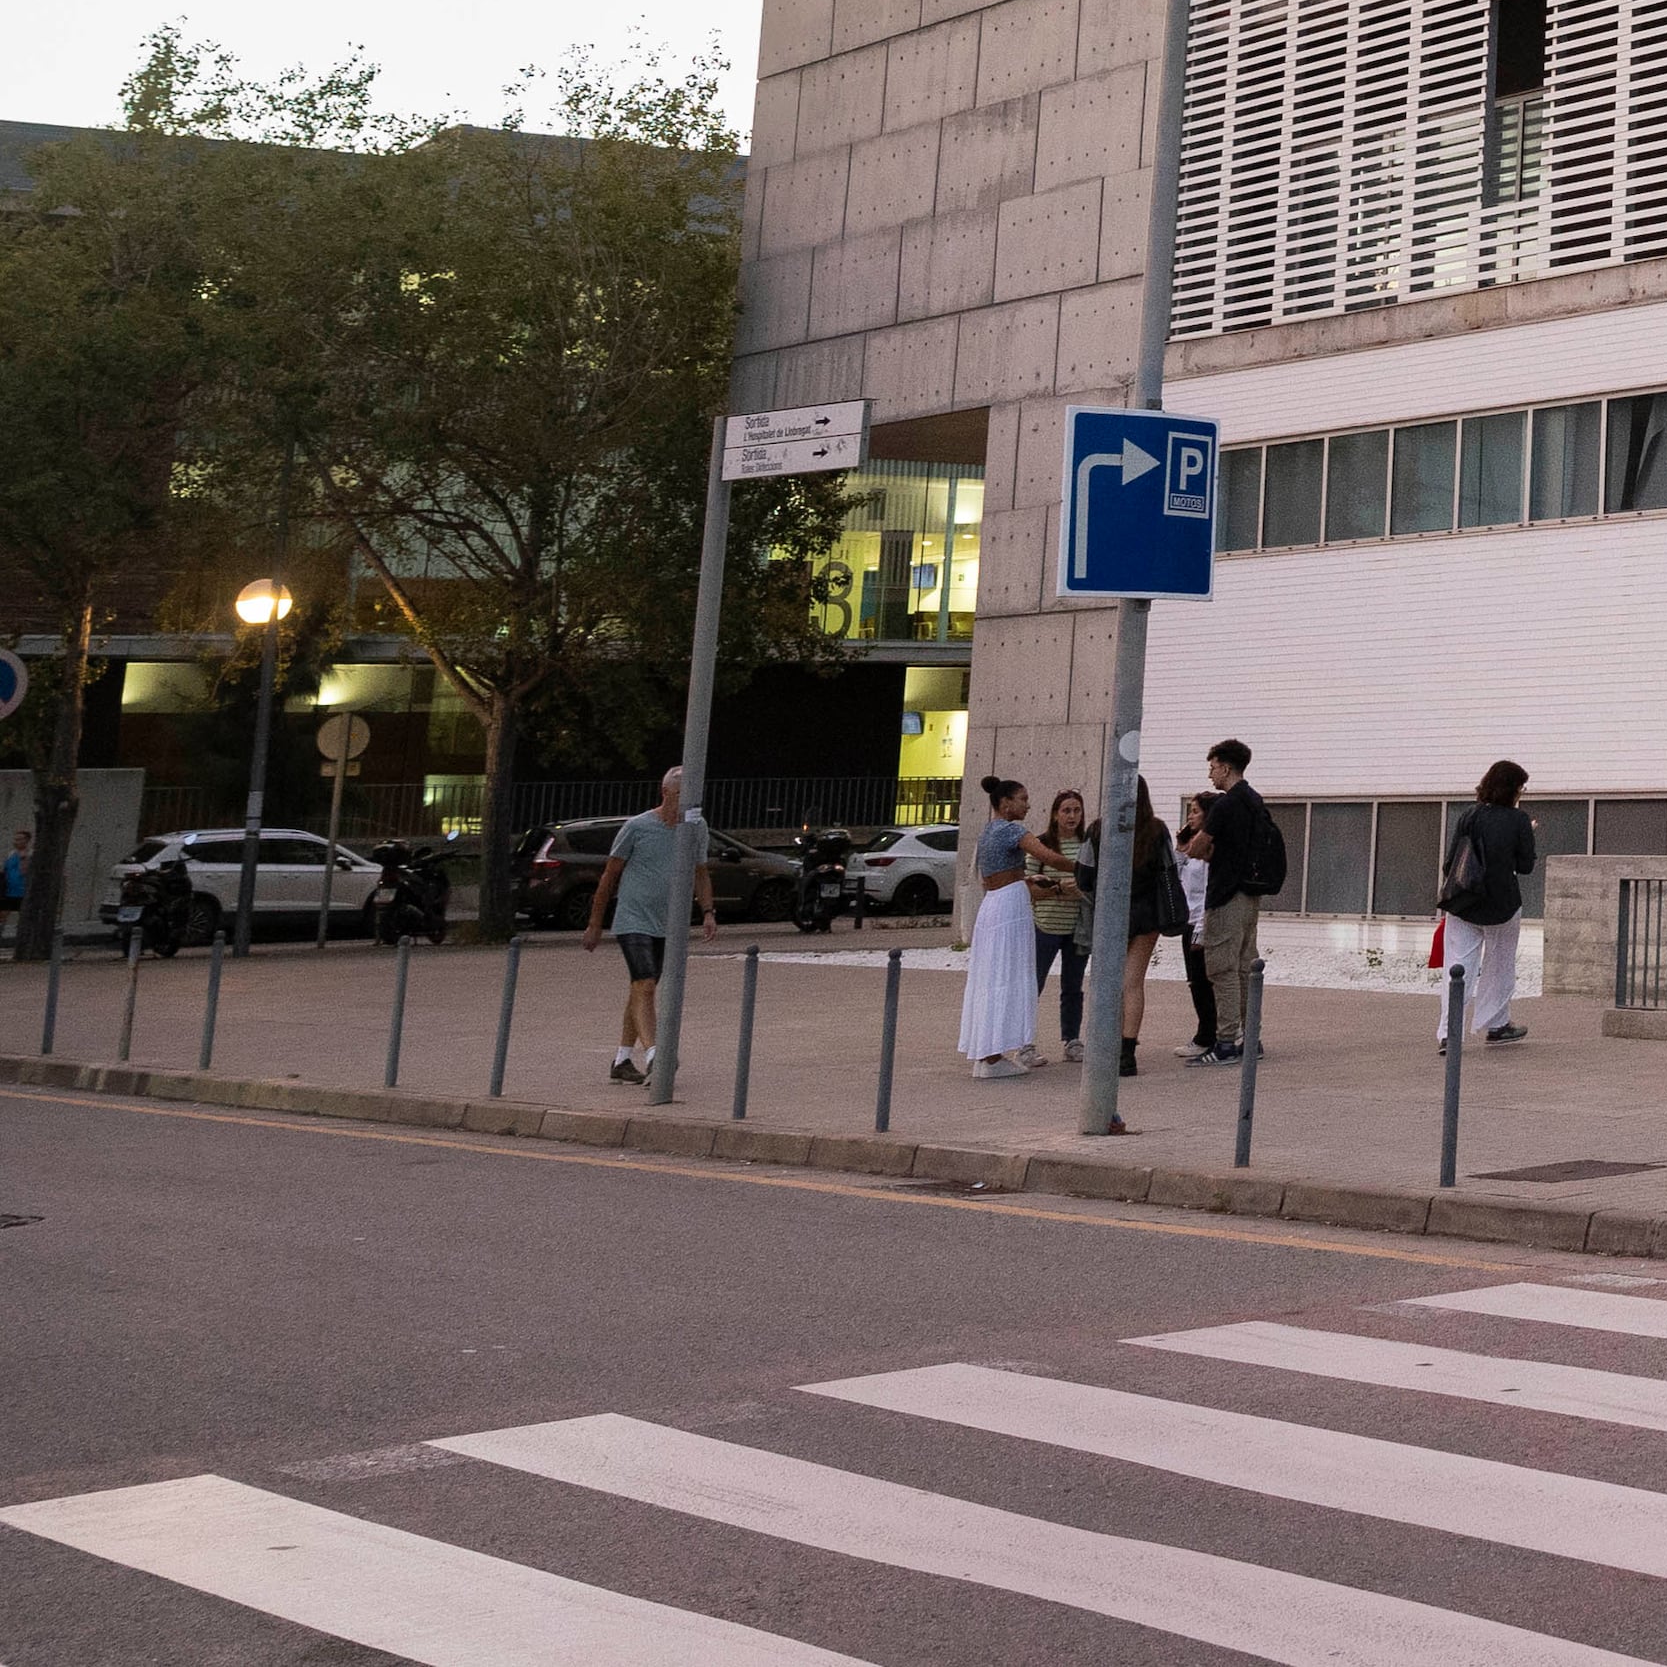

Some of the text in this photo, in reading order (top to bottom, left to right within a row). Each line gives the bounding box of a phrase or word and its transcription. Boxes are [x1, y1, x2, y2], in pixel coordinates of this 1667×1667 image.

[745, 416, 770, 429] Sortida
[785, 425, 811, 437] Llobregat
[742, 449, 767, 461] Sortida
[1180, 447, 1204, 490] P
[1173, 497, 1202, 508] MOTOS
